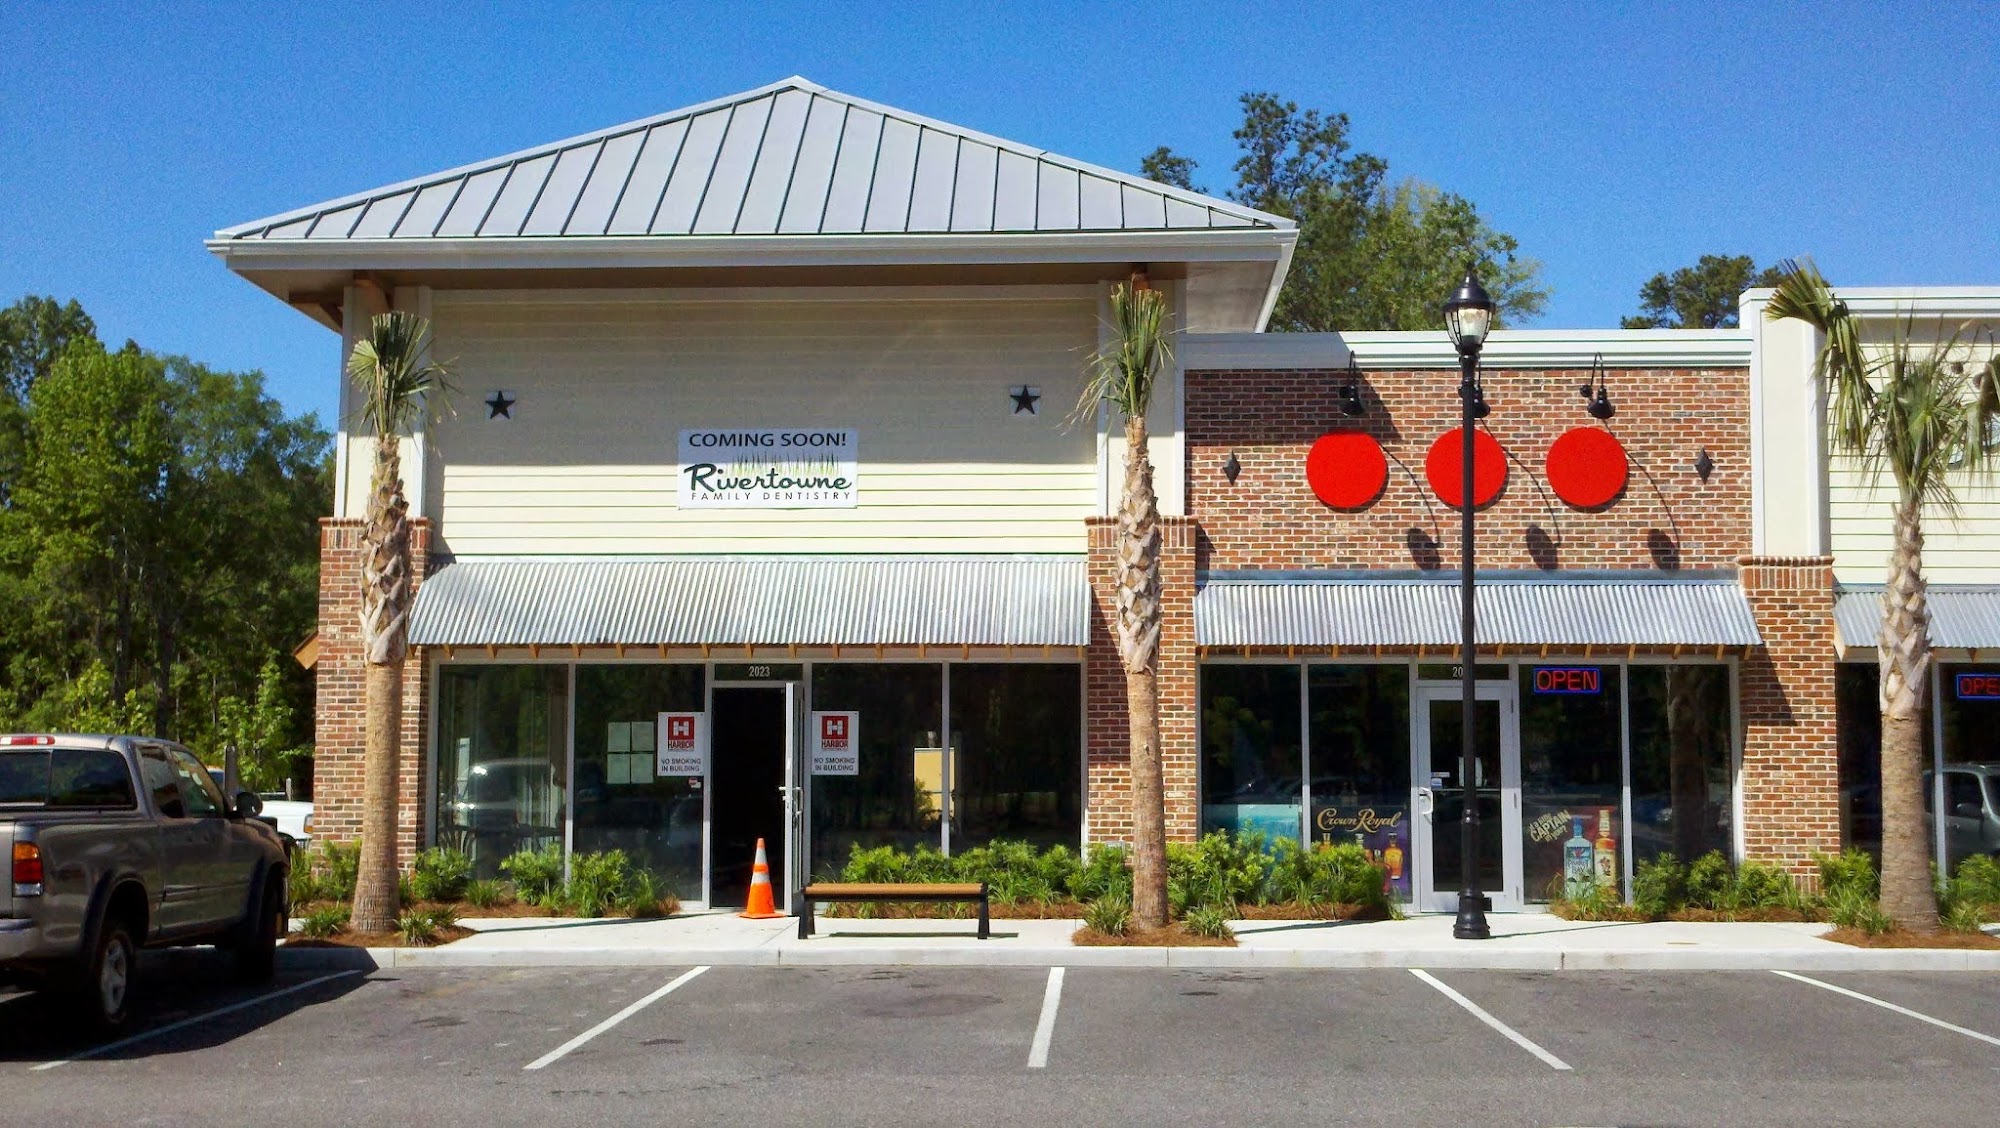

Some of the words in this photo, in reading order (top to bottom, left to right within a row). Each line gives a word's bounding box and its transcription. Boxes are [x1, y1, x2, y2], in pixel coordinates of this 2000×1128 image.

[689, 433, 774, 447] COMING
[781, 432, 847, 447] SOON!
[683, 463, 852, 492] Rivertowne
[692, 492, 751, 500] FAMILY
[763, 492, 850, 500] DENTISTRY
[749, 665, 771, 678] 2023
[1452, 666, 1464, 678] 20
[1536, 670, 1598, 691] OPEN
[1960, 677, 2000, 695] OPE
[673, 721, 689, 736] H
[827, 720, 843, 735] H
[668, 740, 694, 749] HARBOR
[822, 740, 848, 748] HARBOR
[1317, 808, 1358, 831] Crown
[1346, 808, 1402, 833] Royal
[1530, 809, 1571, 842] CAPTAIN
